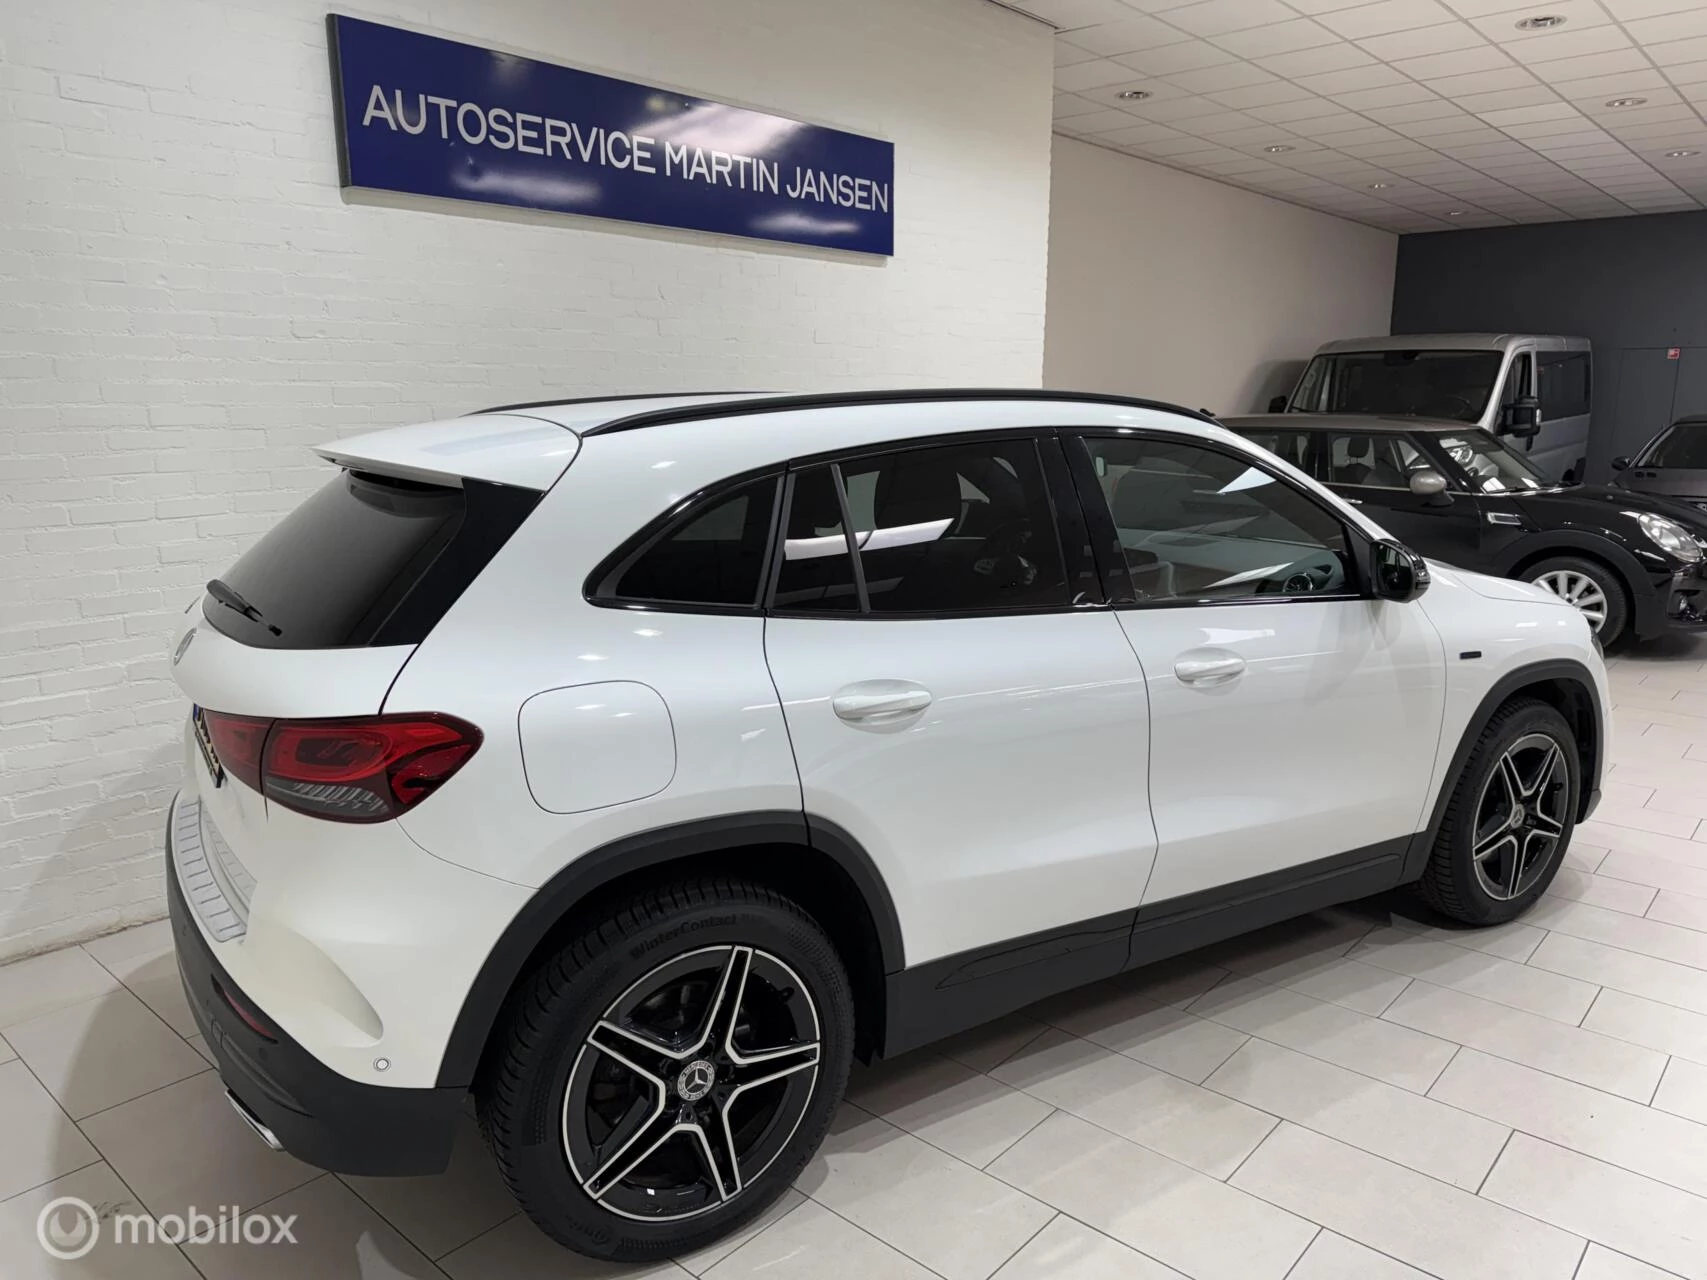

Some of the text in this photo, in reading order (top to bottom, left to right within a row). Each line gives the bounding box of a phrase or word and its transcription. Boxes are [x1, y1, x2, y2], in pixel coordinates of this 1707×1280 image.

[362, 84, 888, 213] AUTOSERVICE MARTIN JANSEN
[629, 914, 737, 960] WinterContact
